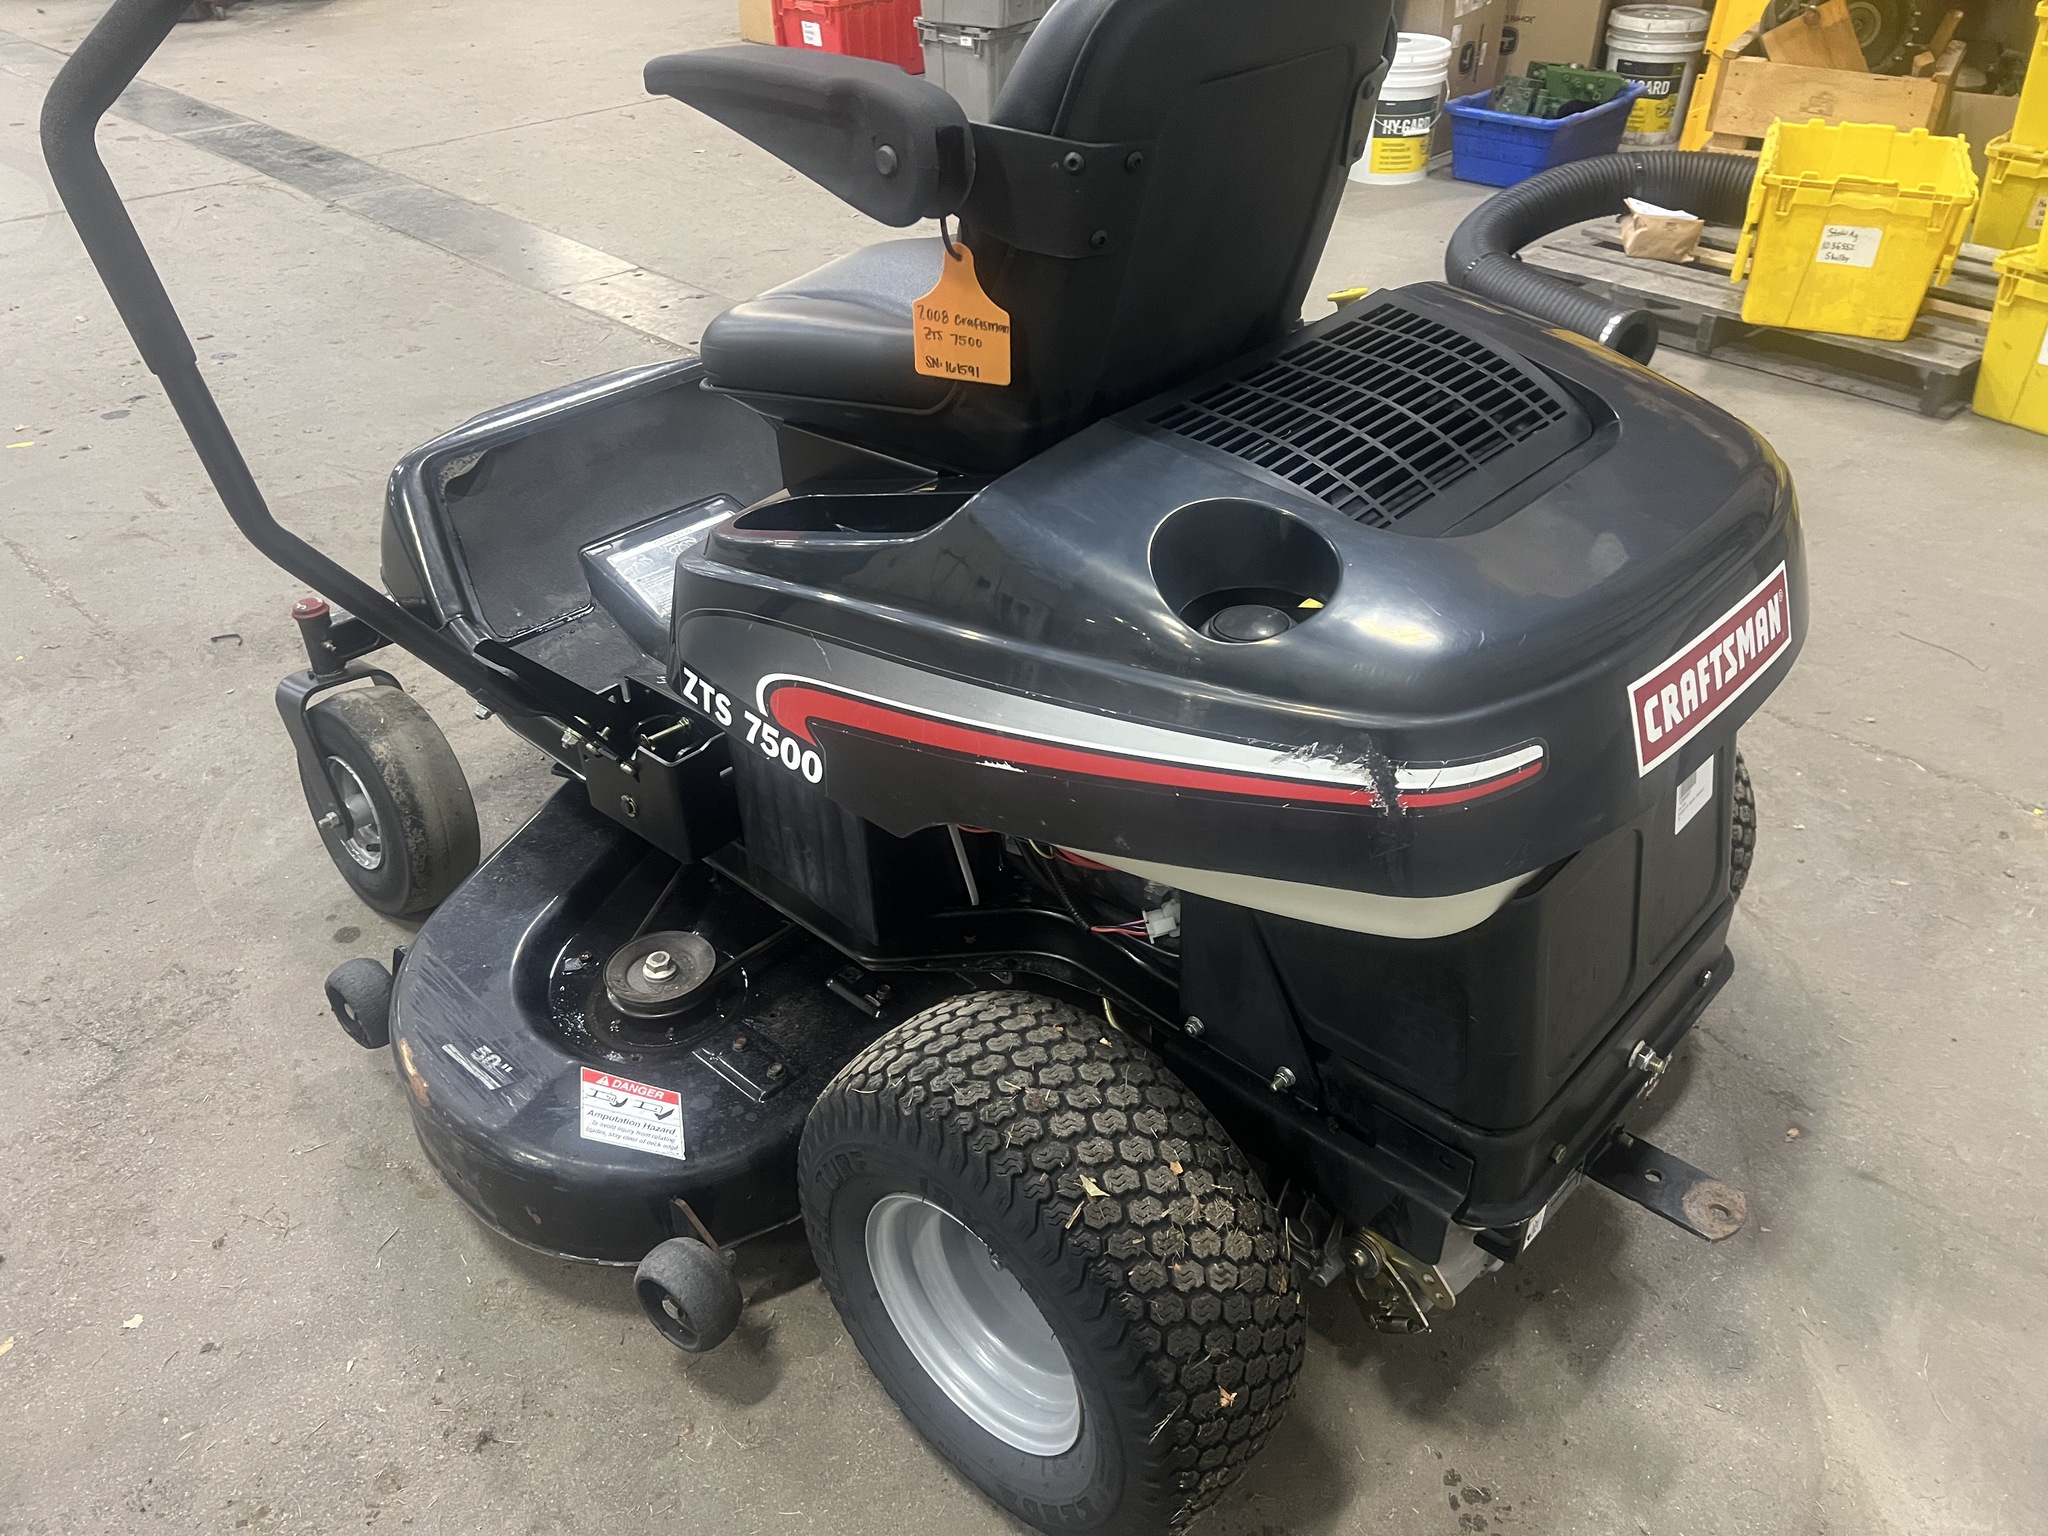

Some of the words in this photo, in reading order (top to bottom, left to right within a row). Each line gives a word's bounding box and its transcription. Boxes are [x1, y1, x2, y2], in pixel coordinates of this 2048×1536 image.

[918, 304, 949, 324] 2008
[950, 334, 982, 348] 7500
[1644, 592, 1782, 743] CRAFTSMAN
[683, 666, 733, 726] ZTS
[744, 710, 823, 784] 7500
[612, 1080, 664, 1100] DANGER
[587, 1110, 640, 1128] Amputation
[642, 1122, 676, 1135] Hazard
[600, 1122, 616, 1130] avoid
[617, 1126, 634, 1136] injury
[636, 1130, 651, 1138] from
[652, 1133, 676, 1144] rotating
[608, 1132, 621, 1140] stay
[622, 1134, 638, 1142] clear
[815, 1150, 868, 1195] TURF
